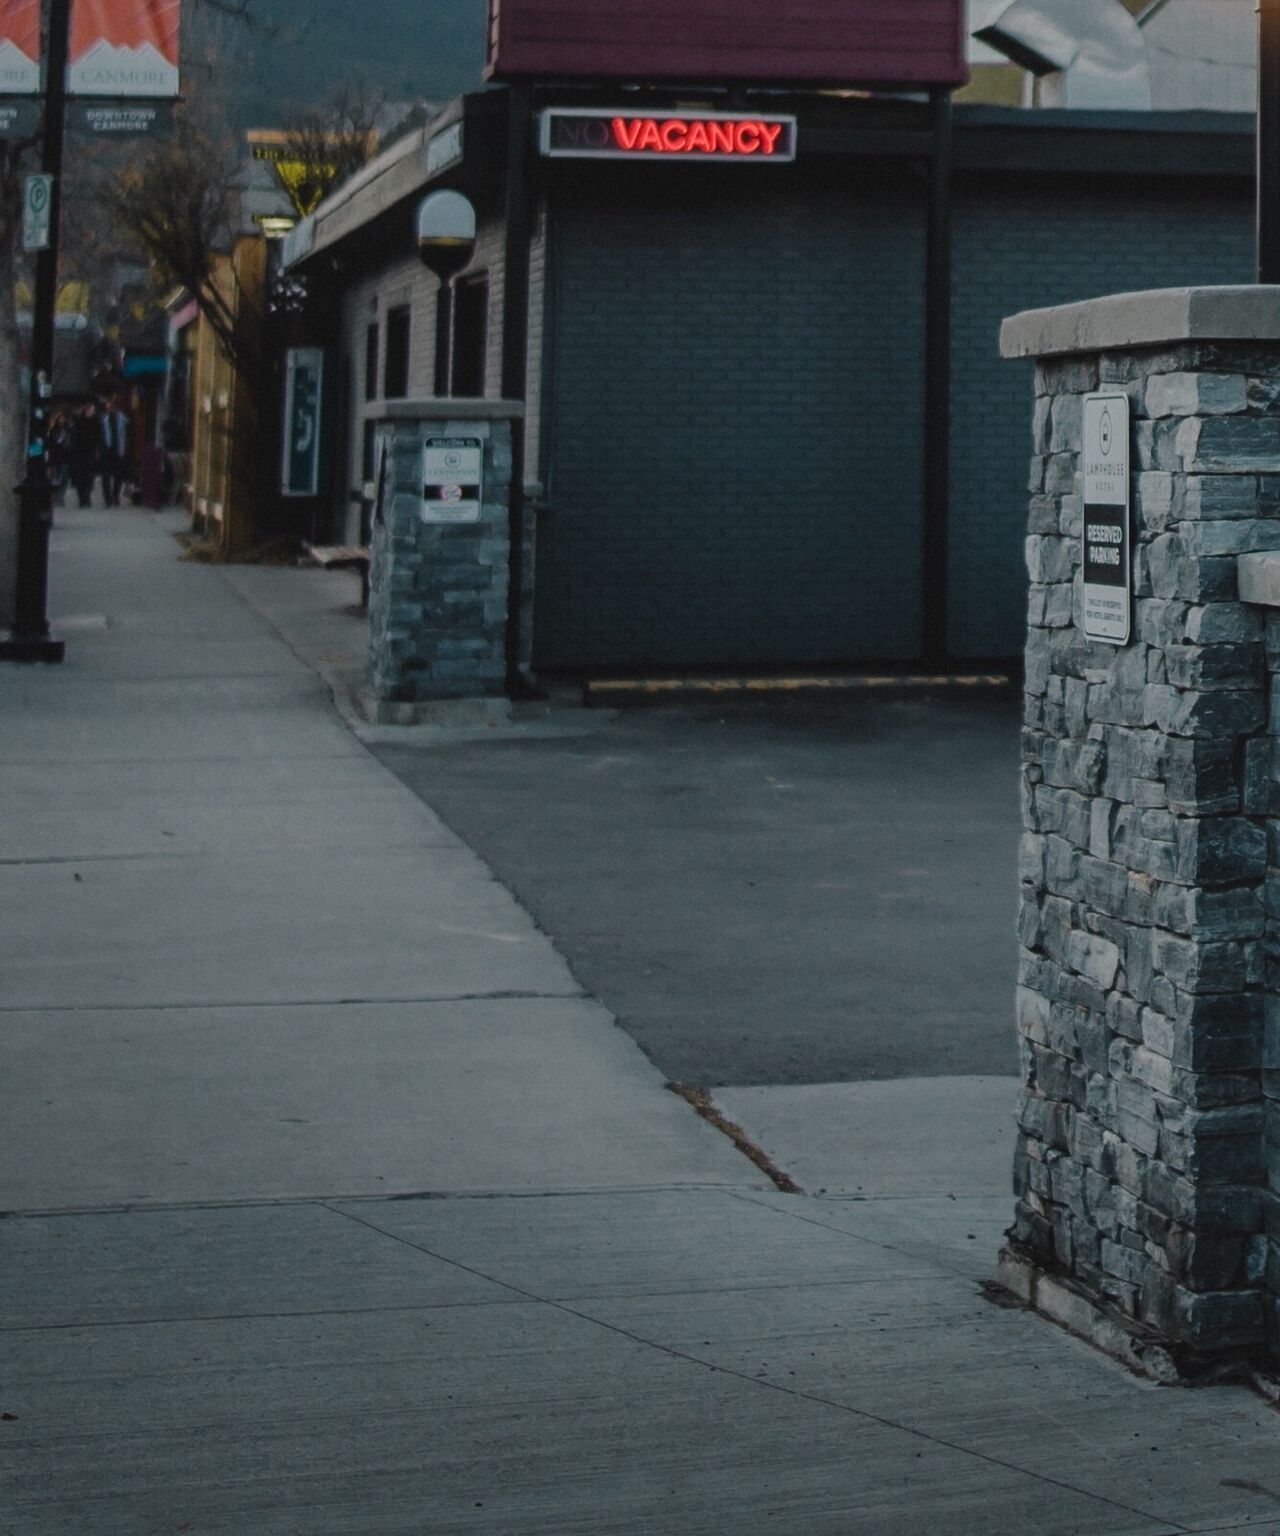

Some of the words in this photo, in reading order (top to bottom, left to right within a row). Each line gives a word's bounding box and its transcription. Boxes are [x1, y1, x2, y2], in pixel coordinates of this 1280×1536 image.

[81, 70, 168, 85] CANMORE
[611, 116, 782, 155] VACANCY
[1087, 524, 1123, 544] RESERVED
[1089, 545, 1120, 566] PARKING
